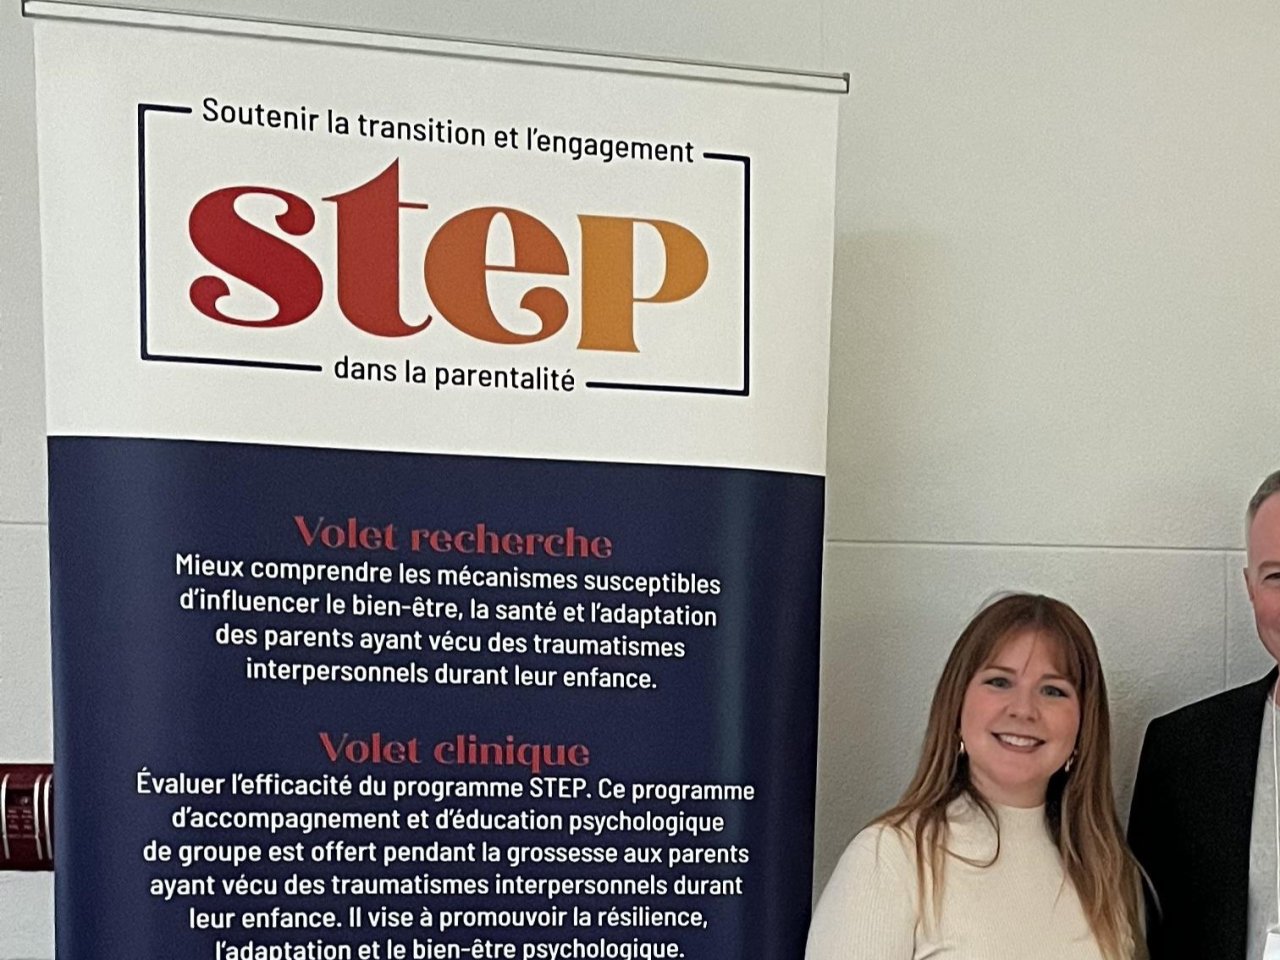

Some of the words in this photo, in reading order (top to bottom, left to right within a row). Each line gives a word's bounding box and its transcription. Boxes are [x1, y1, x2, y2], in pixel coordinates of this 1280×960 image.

[203, 98, 319, 131] Soutenir
[328, 109, 349, 134] la
[358, 115, 484, 146] transition
[495, 128, 518, 149] et
[528, 127, 694, 163] l'engagement
[189, 157, 709, 352] step
[335, 355, 396, 381] dans
[406, 360, 426, 383] la
[436, 367, 574, 392] parentalité
[294, 516, 395, 549] Volet
[412, 525, 613, 556] recherche
[177, 553, 244, 577] Mieux
[251, 561, 392, 585] comprendre
[400, 563, 430, 584] les
[438, 565, 577, 589] mécanismes
[584, 572, 720, 597] susceptibles
[180, 588, 319, 613] d'influencer
[327, 593, 345, 614] le
[353, 594, 463, 620] bien-être,
[471, 598, 489, 619] la
[496, 601, 556, 621] santé
[564, 603, 584, 622] et
[591, 602, 716, 629] l'adaptation
[216, 623, 257, 645] des
[265, 628, 353, 650] parents
[360, 631, 422, 654] ayant
[429, 630, 481, 651] vécu
[488, 632, 527, 653] des
[533, 634, 685, 657] traumatismes
[247, 657, 428, 685] interpersonnels
[435, 663, 508, 685] durant
[515, 665, 557, 686] leur
[564, 667, 656, 688] enfance.
[320, 732, 418, 762] Volet
[435, 736, 590, 773] clinique
[137, 767, 225, 794] Évaluer
[232, 773, 352, 795] l'efficacité
[359, 775, 386, 796] du
[394, 780, 523, 802] programme
[530, 777, 591, 798] STEP.
[599, 778, 625, 798] Ce
[632, 784, 754, 804] programme
[172, 806, 400, 834] d'accompagnement
[407, 810, 429, 829] et
[436, 808, 562, 830] d'éducation
[570, 810, 724, 836] psychologique
[144, 840, 171, 861] de
[179, 845, 261, 867] groupe
[269, 842, 304, 861] est
[311, 841, 376, 861] offert
[384, 841, 475, 866] pendant
[482, 841, 500, 862] la
[507, 847, 617, 867] grossesse
[624, 847, 662, 863] aux
[669, 845, 749, 868] parents
[150, 876, 215, 900] ayant
[222, 874, 277, 895] vécu
[284, 874, 325, 894] des
[331, 873, 489, 894] traumatismes
[496, 873, 667, 899] interpersonnels
[674, 875, 743, 895] durant
[190, 907, 235, 929] leur
[242, 907, 341, 928] enfance.
[350, 907, 361, 927] Il
[368, 906, 413, 927] vise
[420, 906, 432, 927] à
[440, 906, 567, 932] promouvoir
[574, 906, 591, 926] la
[598, 906, 707, 928] résilience,
[358, 941, 380, 960] et
[388, 939, 406, 959] le
[413, 939, 516, 959] bien-être
